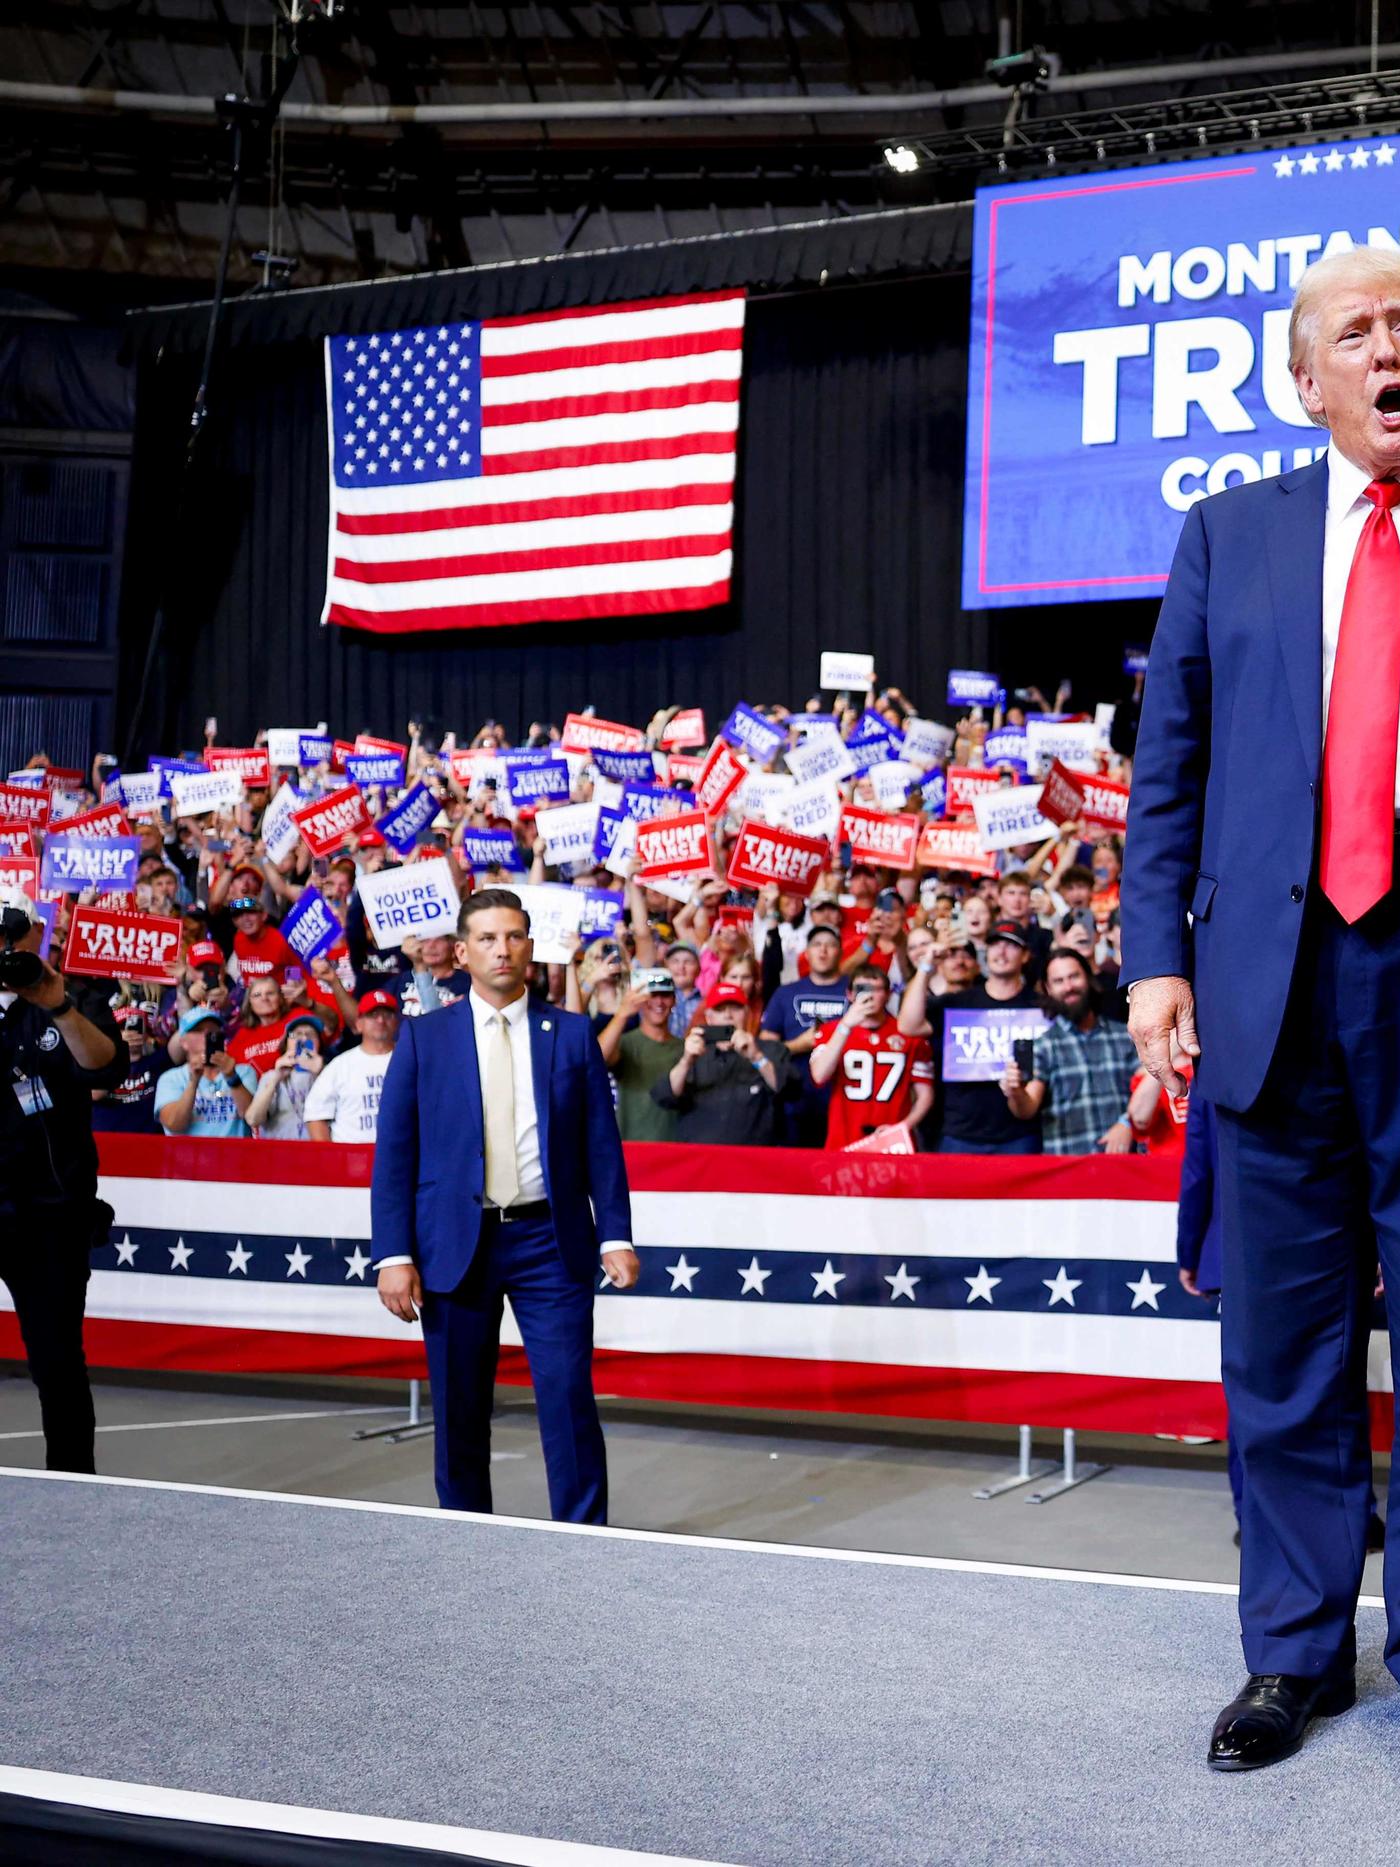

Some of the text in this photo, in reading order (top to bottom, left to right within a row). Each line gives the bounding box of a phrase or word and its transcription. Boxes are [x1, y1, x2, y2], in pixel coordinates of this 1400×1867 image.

[213, 756, 267, 773] TRUMP
[348, 759, 401, 773] TRUMP
[0, 793, 48, 809] RUMP
[626, 791, 695, 811] TRUP
[56, 813, 122, 837] RUMP
[301, 795, 363, 835] TRUMP
[988, 813, 1045, 836] FIRED
[549, 831, 593, 850] FIRE
[638, 823, 706, 852] TRUMP
[842, 815, 914, 841] TRUMP
[643, 838, 701, 863] VANCE
[744, 833, 822, 869] TRUMP
[848, 829, 905, 855] VANCE
[50, 846, 136, 866] TRUMP
[748, 850, 809, 881] VANCE
[59, 862, 126, 880] VANCE
[374, 884, 440, 910] YOU'RE
[287, 898, 324, 951] TRUMP
[374, 898, 452, 931] FIRED!
[77, 920, 178, 951] TRUMP
[86, 937, 166, 963] VANCE
[237, 960, 275, 975] TRUMP
[951, 1026, 1050, 1047] TRUMP
[962, 1041, 1015, 1059] VAN
[843, 1049, 906, 1102] 97
